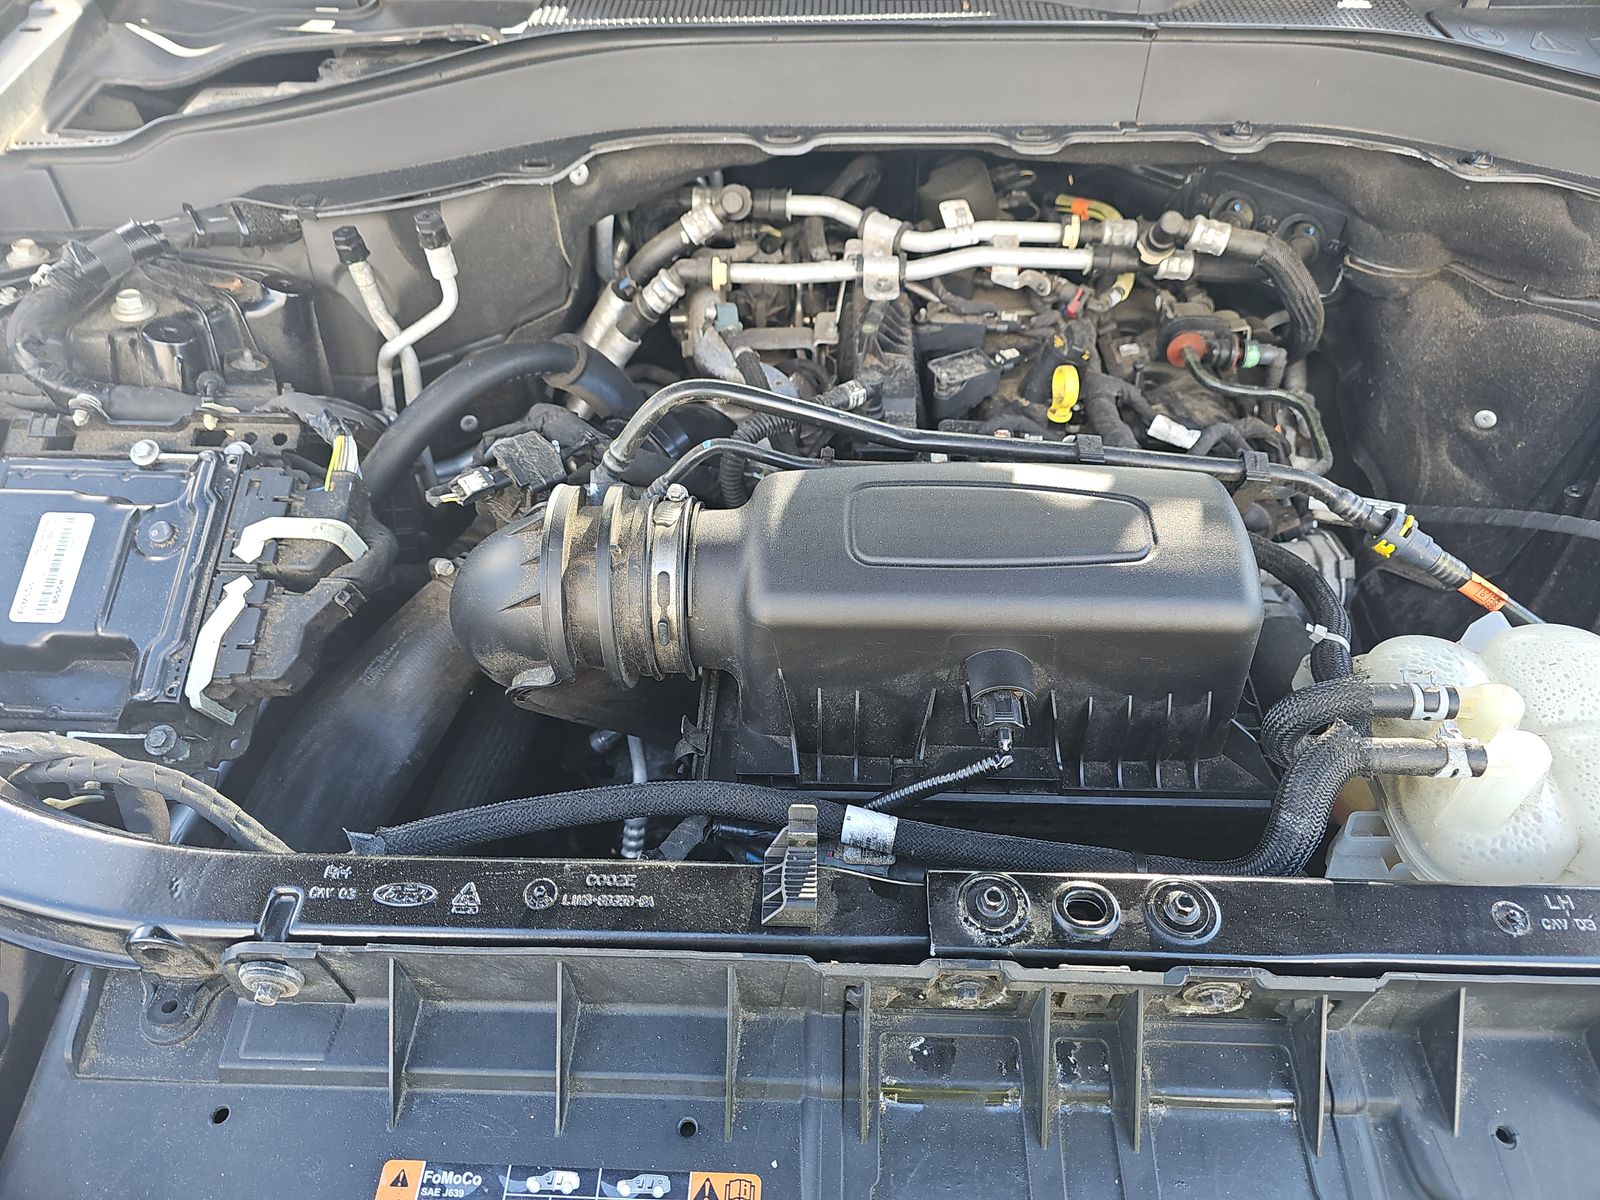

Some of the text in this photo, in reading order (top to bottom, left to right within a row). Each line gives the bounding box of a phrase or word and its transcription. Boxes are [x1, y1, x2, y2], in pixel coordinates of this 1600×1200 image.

[1543, 894, 1575, 910] LH
[422, 1170, 482, 1186] FoMoCo
[420, 1186, 465, 1198] SAE J639
